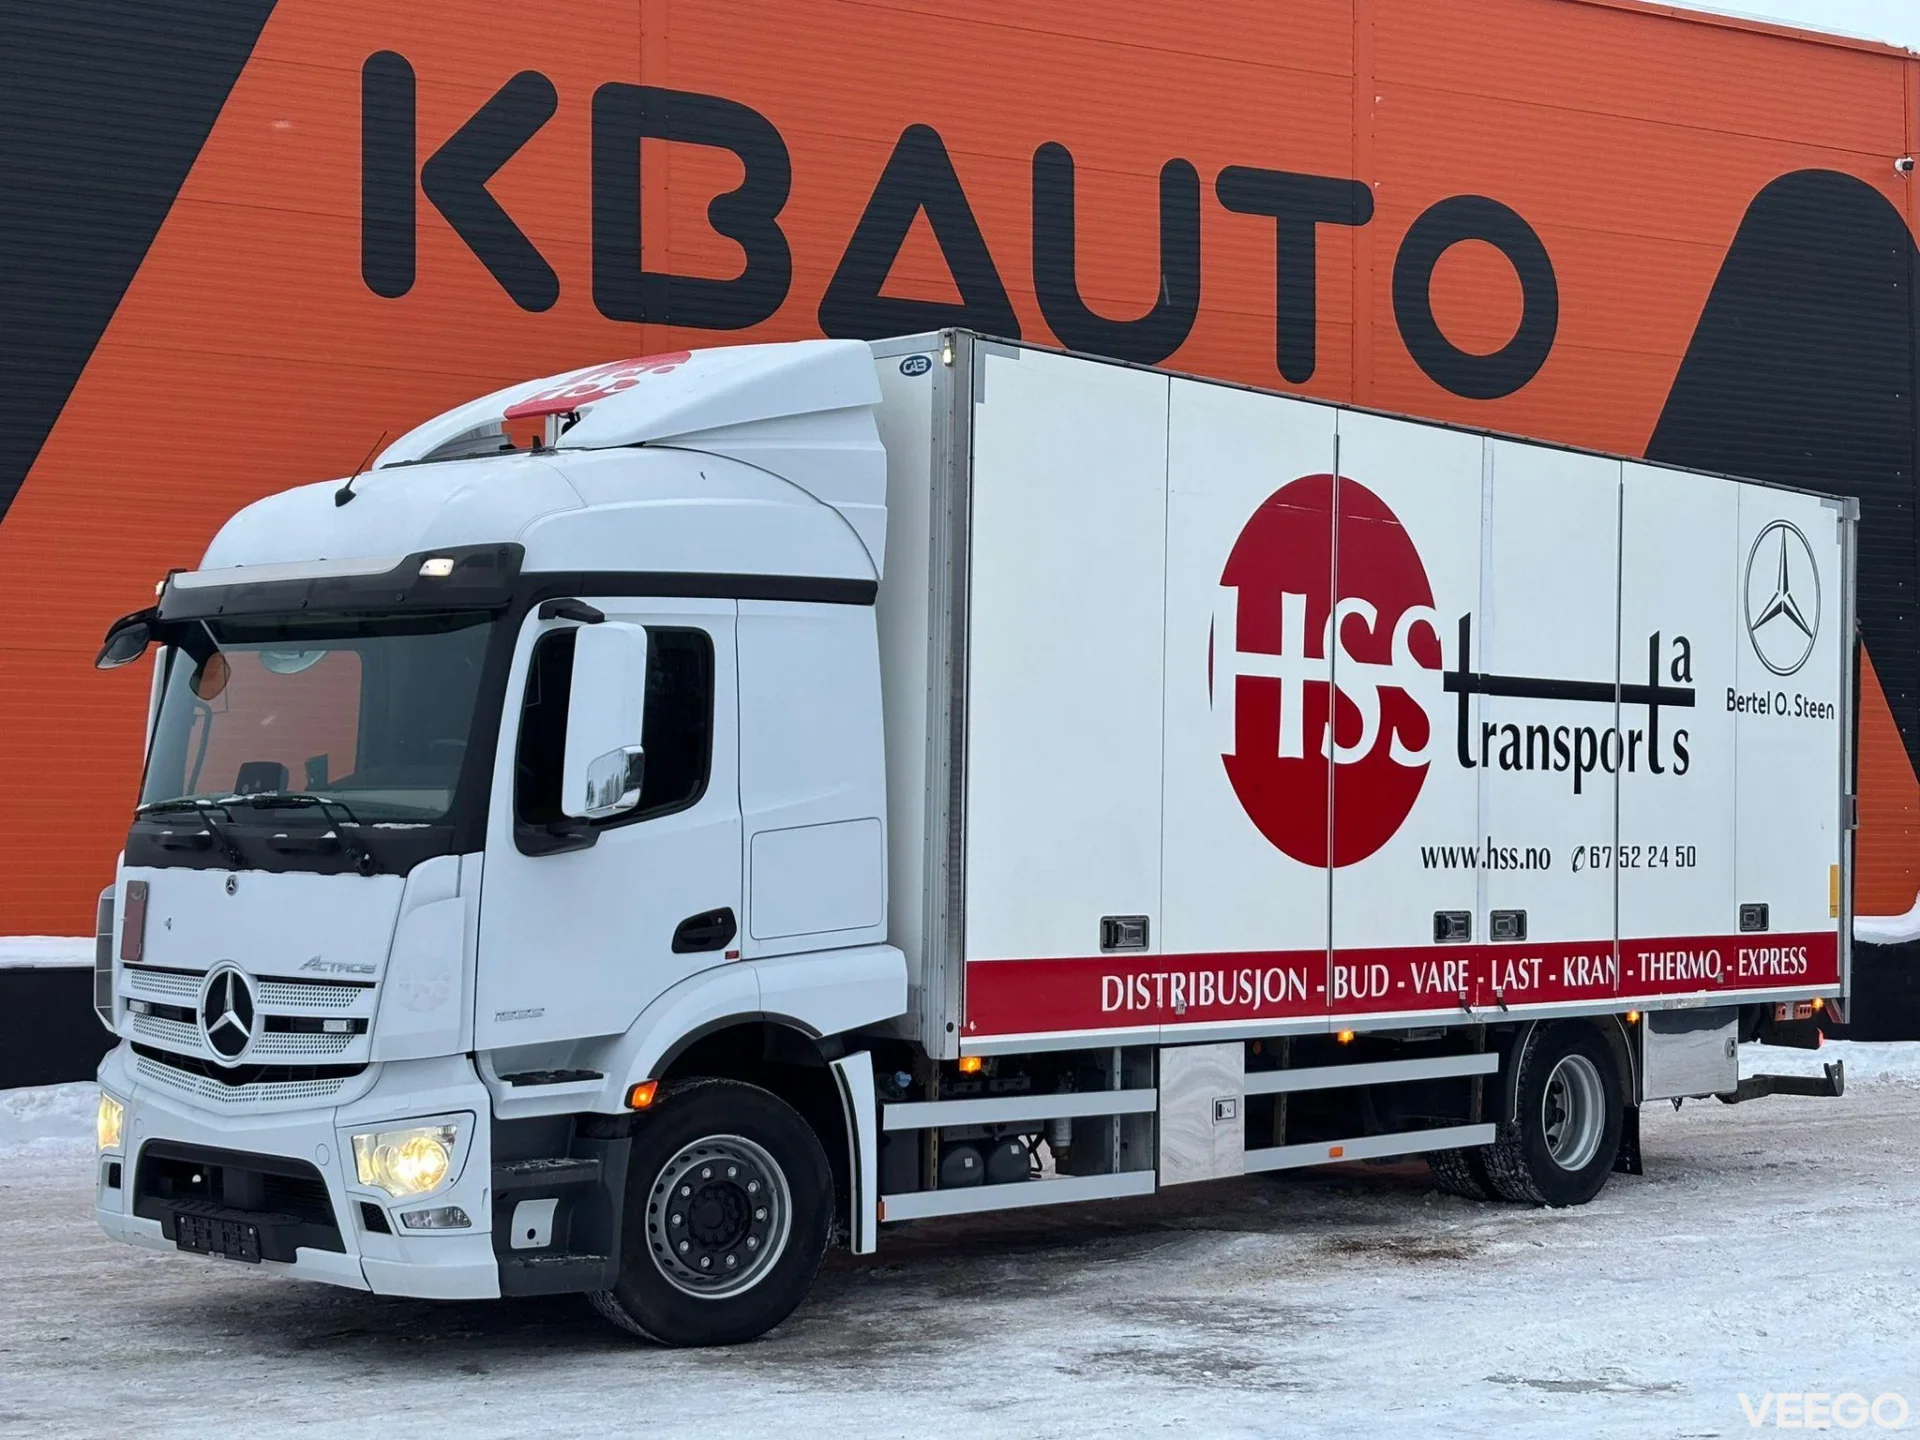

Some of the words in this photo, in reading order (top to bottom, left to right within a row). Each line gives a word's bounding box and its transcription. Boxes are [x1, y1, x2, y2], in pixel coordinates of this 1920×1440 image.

[361, 50, 1558, 399] KBAUTO
[1213, 584, 1442, 768] HSS
[1726, 687, 1771, 715] Bertel
[1774, 691, 1791, 716] O.
[1794, 693, 1835, 720] Steen
[1421, 836, 1551, 870] www.hss.no
[1590, 846, 1612, 869] 67
[1619, 846, 1641, 868] 52
[1648, 846, 1669, 868] 24
[1675, 846, 1697, 868] 50
[1101, 966, 1308, 1012] DISTRIBUSJON
[1334, 964, 1390, 999] BUD
[1410, 959, 1469, 994] VARE
[1491, 957, 1544, 991] LAST
[1563, 955, 1617, 988] KRAN
[1638, 949, 1721, 982] THERMO
[1738, 946, 1808, 977] EXPRESS
